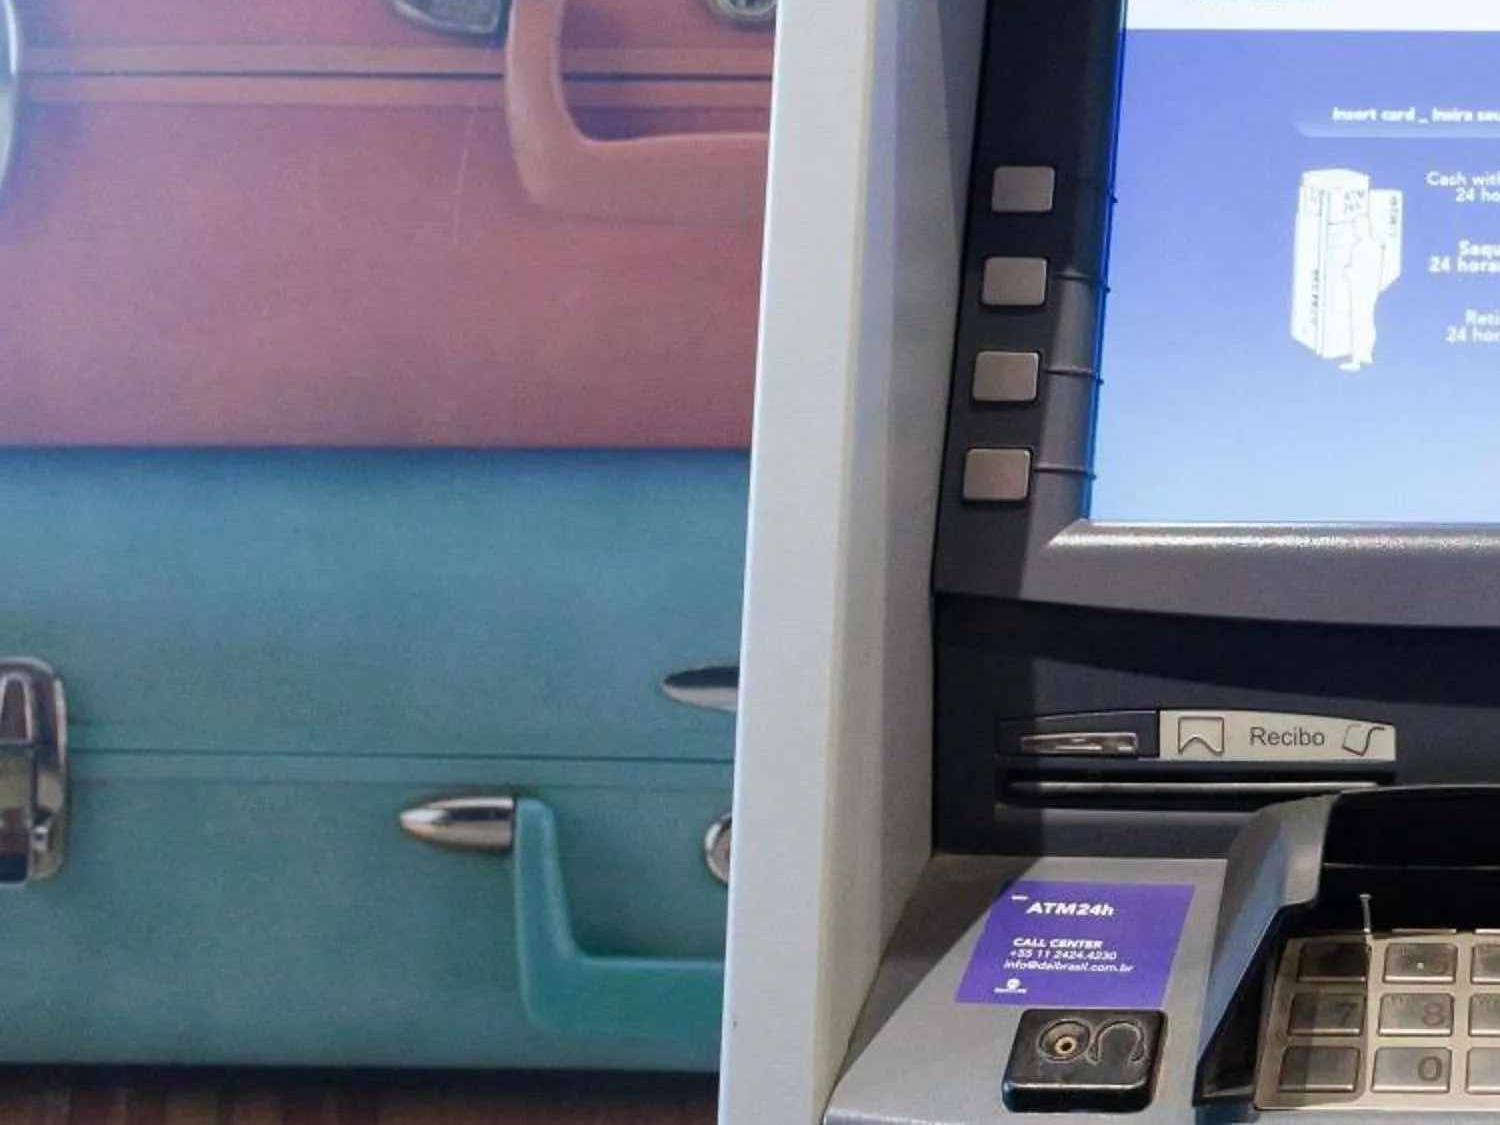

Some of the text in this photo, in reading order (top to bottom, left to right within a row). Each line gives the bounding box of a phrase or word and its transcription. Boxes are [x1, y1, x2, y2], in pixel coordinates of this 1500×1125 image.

[1332, 106, 1377, 122] Insert
[1381, 106, 1416, 122] card
[1432, 106, 1473, 122] Insira
[1426, 172, 1467, 187] Cash
[1456, 188, 1476, 203] 24
[1429, 257, 1451, 273] 24
[1445, 327, 1468, 343] 24
[1249, 726, 1326, 747] Recibo
[1025, 901, 1115, 917] ATM24h
[1013, 937, 1103, 949] CALL CENTER
[1010, 948, 1033, 958] +55
[1036, 950, 1050, 959] 11
[1422, 1002, 1446, 1027] 8
[1417, 1055, 1443, 1083] 0
